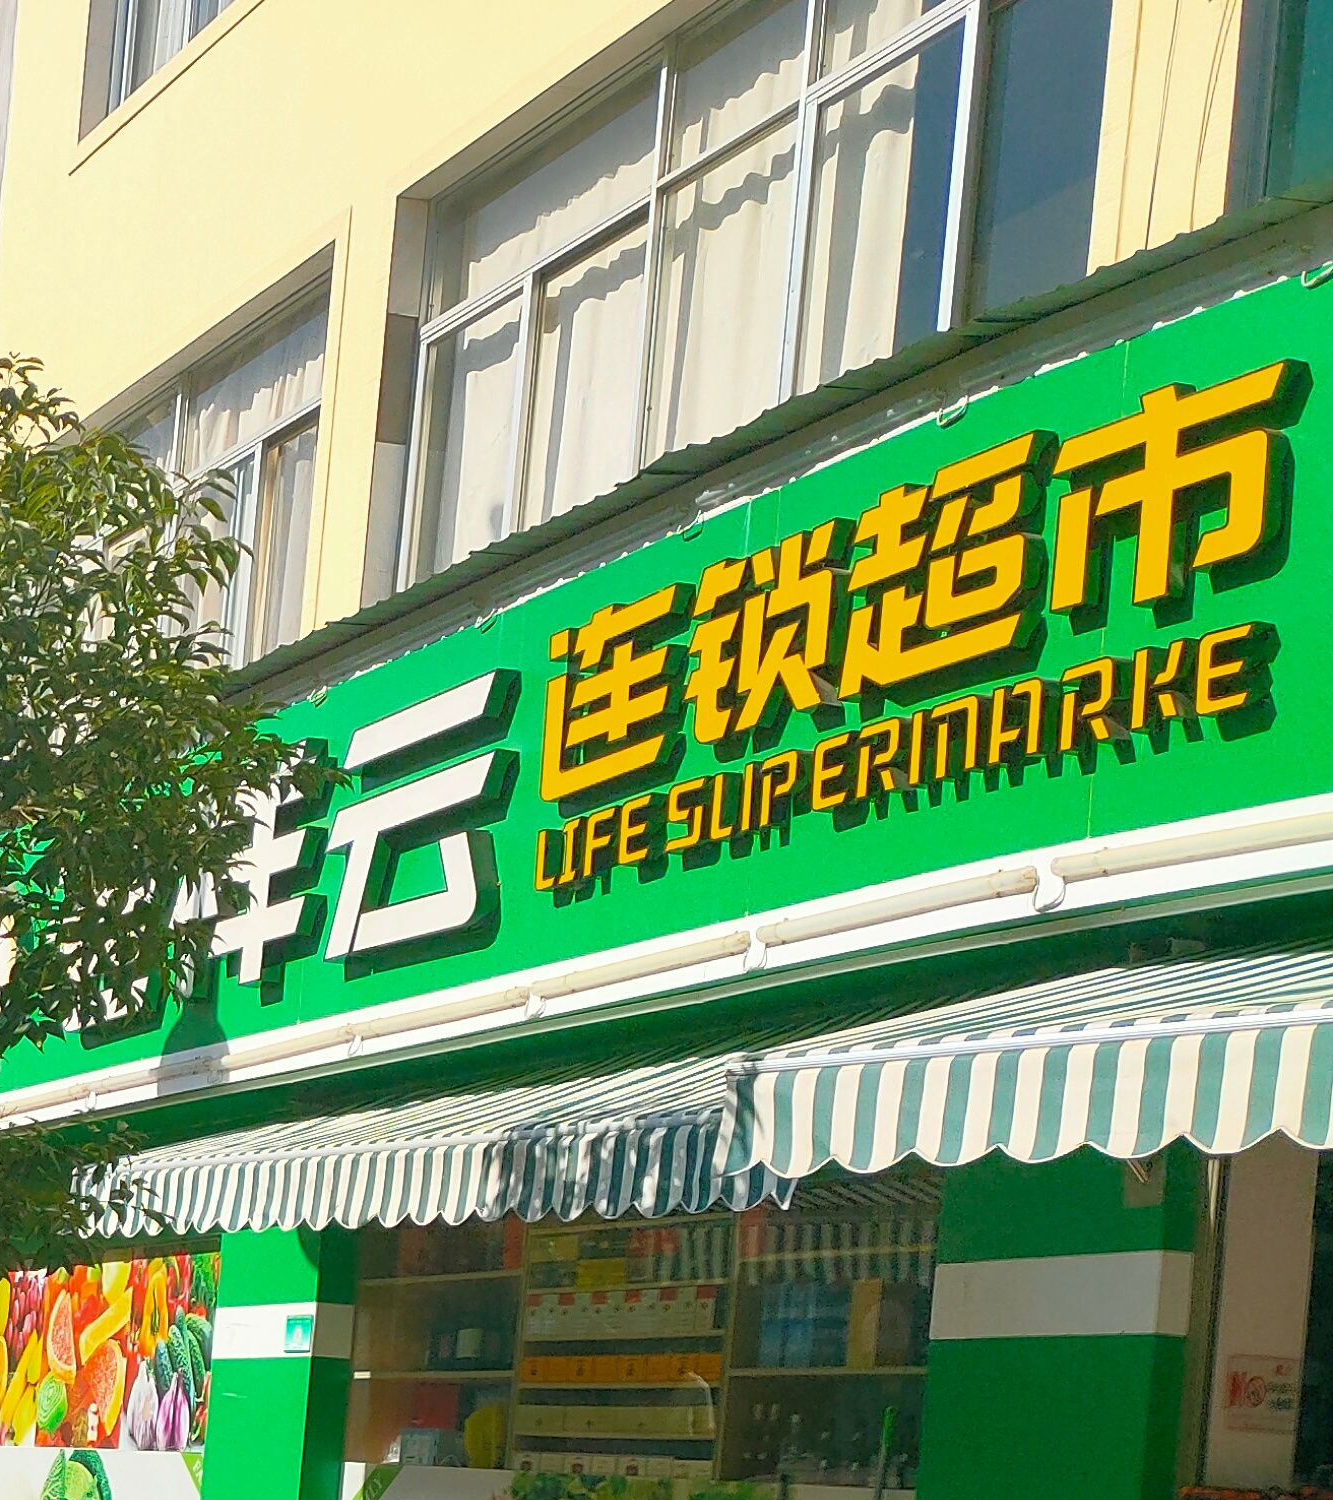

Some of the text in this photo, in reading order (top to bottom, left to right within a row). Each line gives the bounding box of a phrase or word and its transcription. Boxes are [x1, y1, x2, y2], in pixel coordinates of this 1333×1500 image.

[534, 622, 1255, 893] LIFE SUPERMARKE
[540, 361, 1288, 802] 连锁超市
